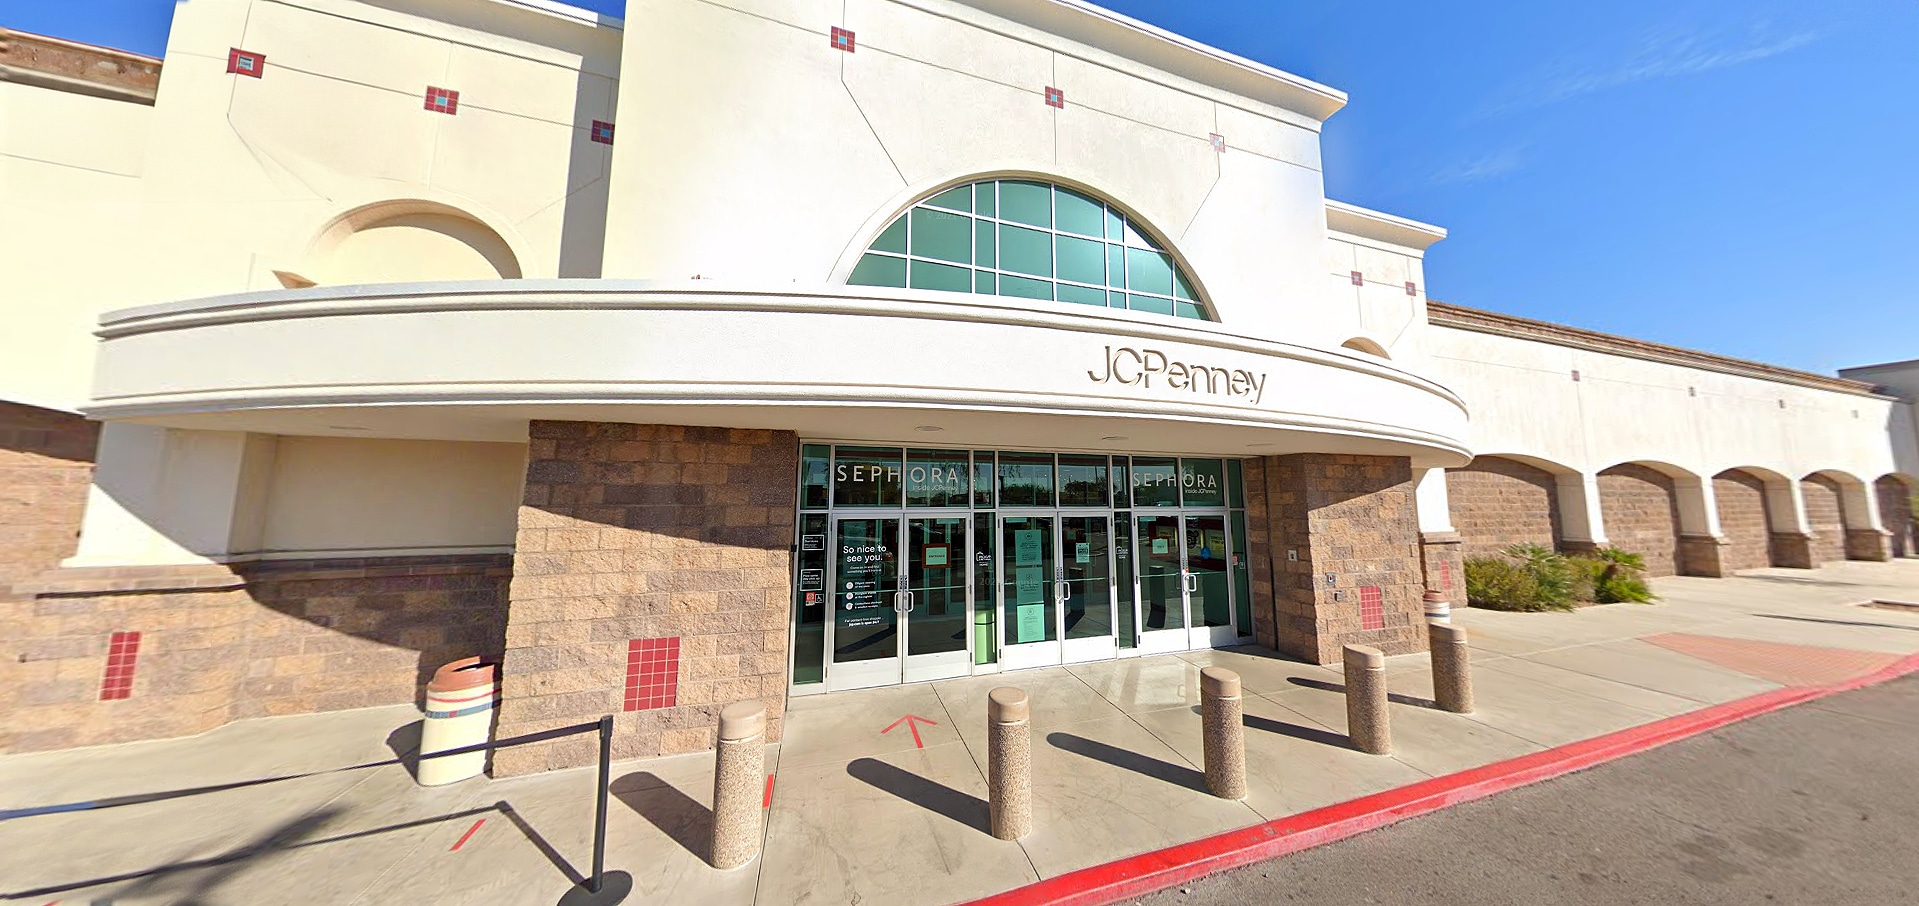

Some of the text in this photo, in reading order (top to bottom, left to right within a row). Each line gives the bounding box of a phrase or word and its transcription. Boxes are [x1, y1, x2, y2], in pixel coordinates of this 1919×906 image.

[1087, 345, 1267, 405] JCPenney
[836, 464, 959, 484] SEPHORA
[1133, 472, 1217, 488] SEPHORA
[843, 543, 887, 554] So nice to
[846, 554, 883, 564] see you.
